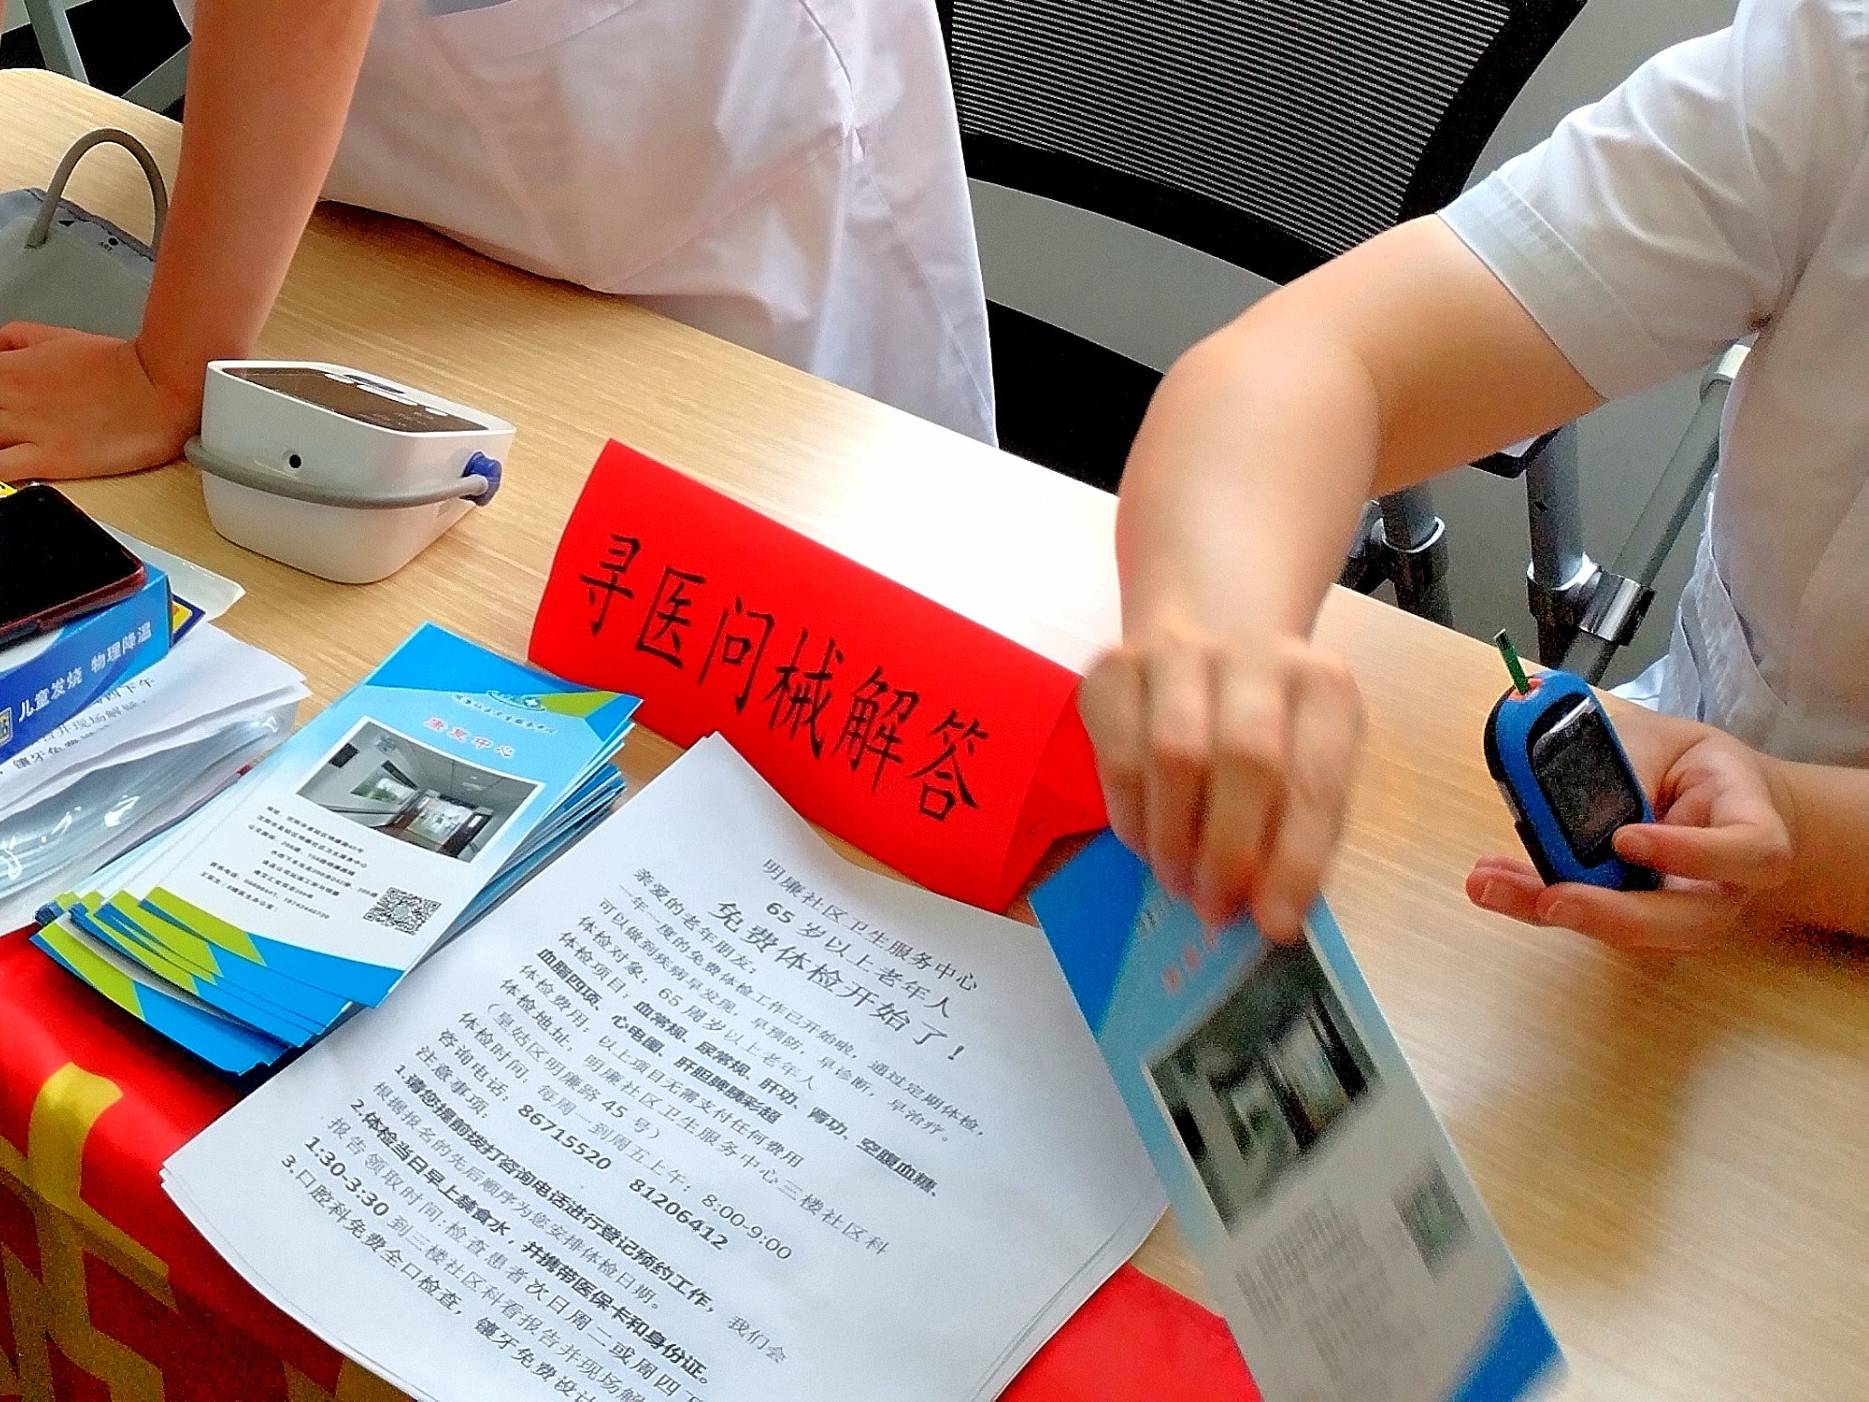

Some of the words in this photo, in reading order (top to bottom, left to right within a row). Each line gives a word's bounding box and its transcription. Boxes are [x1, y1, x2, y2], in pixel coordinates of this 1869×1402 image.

[19, 668, 83, 722] 儿童发烧
[91, 622, 152, 672] 物理降温
[579, 533, 989, 822] 寻医问械解答
[766, 902, 796, 923] 65
[601, 1101, 628, 1118] 45
[304, 1136, 389, 1222] 1:30-3:30
[629, 1179, 728, 1250] 81206412
